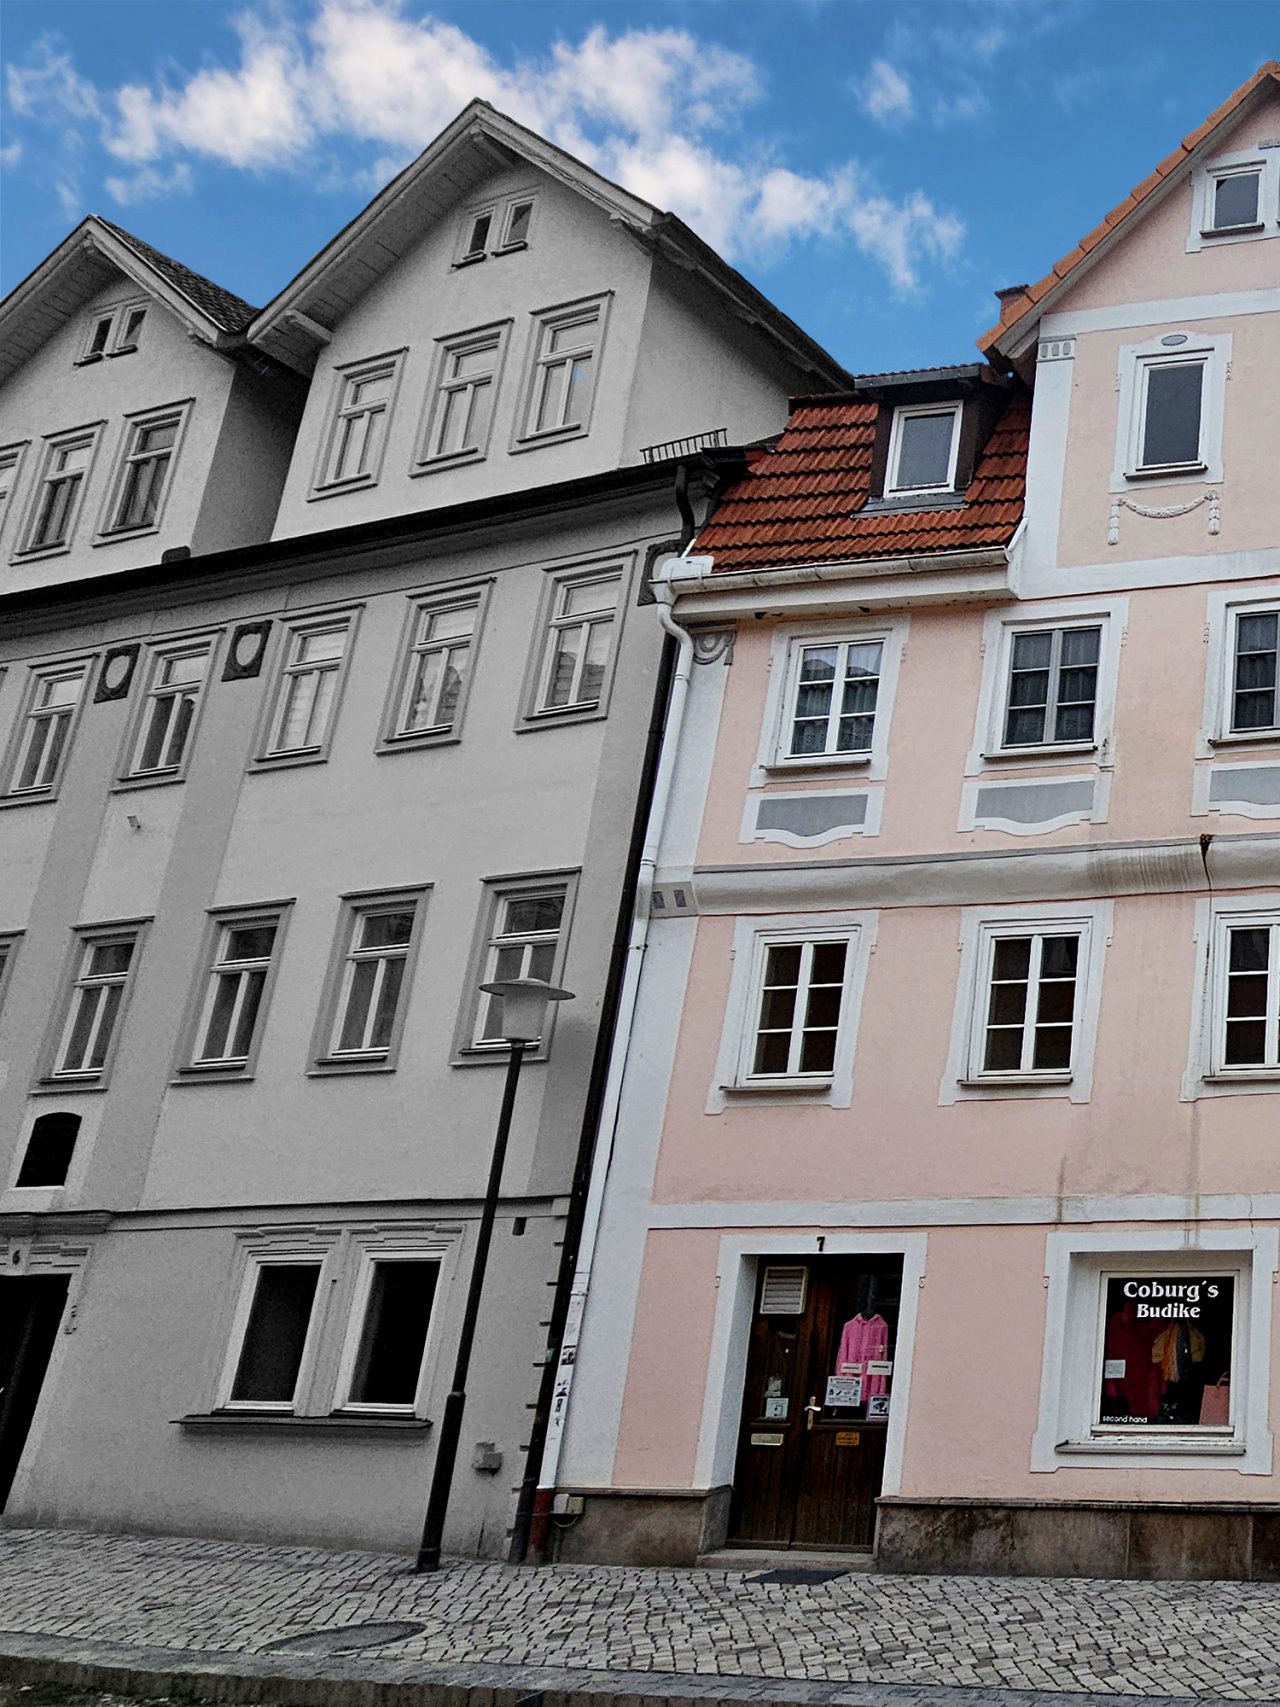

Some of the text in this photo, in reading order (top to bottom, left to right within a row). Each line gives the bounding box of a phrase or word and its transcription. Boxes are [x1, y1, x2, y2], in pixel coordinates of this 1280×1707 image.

[816, 1236, 826, 1252] 7
[12, 1249, 20, 1265] 6
[1136, 1303, 1201, 1318] Budike
[1102, 1415, 1148, 1424] second hand
